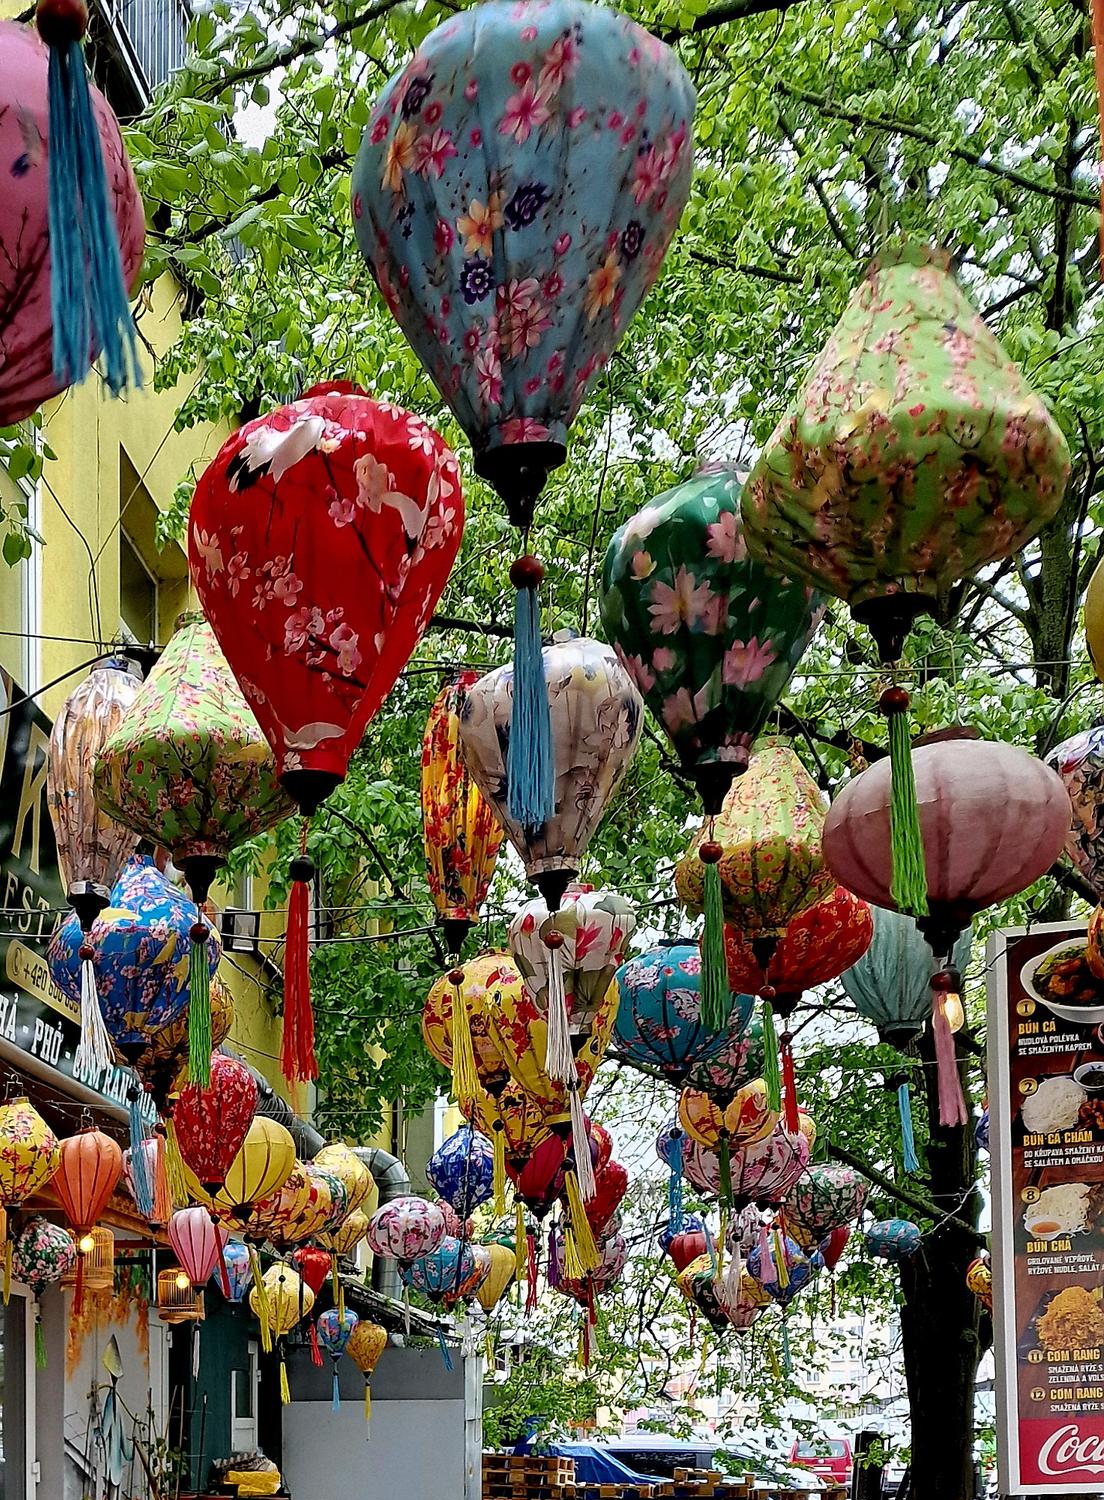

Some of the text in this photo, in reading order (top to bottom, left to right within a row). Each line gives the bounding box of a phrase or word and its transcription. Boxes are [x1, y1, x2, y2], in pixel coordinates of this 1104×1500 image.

[23, 962, 49, 992] +420
[1018, 1017, 1056, 1035] BÚN CÁ
[1018, 1047, 1027, 1056] SE
[1065, 1042, 1093, 1052] KAPREM
[1023, 1150, 1033, 1158] DO
[1024, 1160, 1033, 1168] SE
[1026, 1239, 1047, 1253] BÚN
[1073, 1349, 1100, 1361] RANG
[1076, 1387, 1103, 1399] RANG
